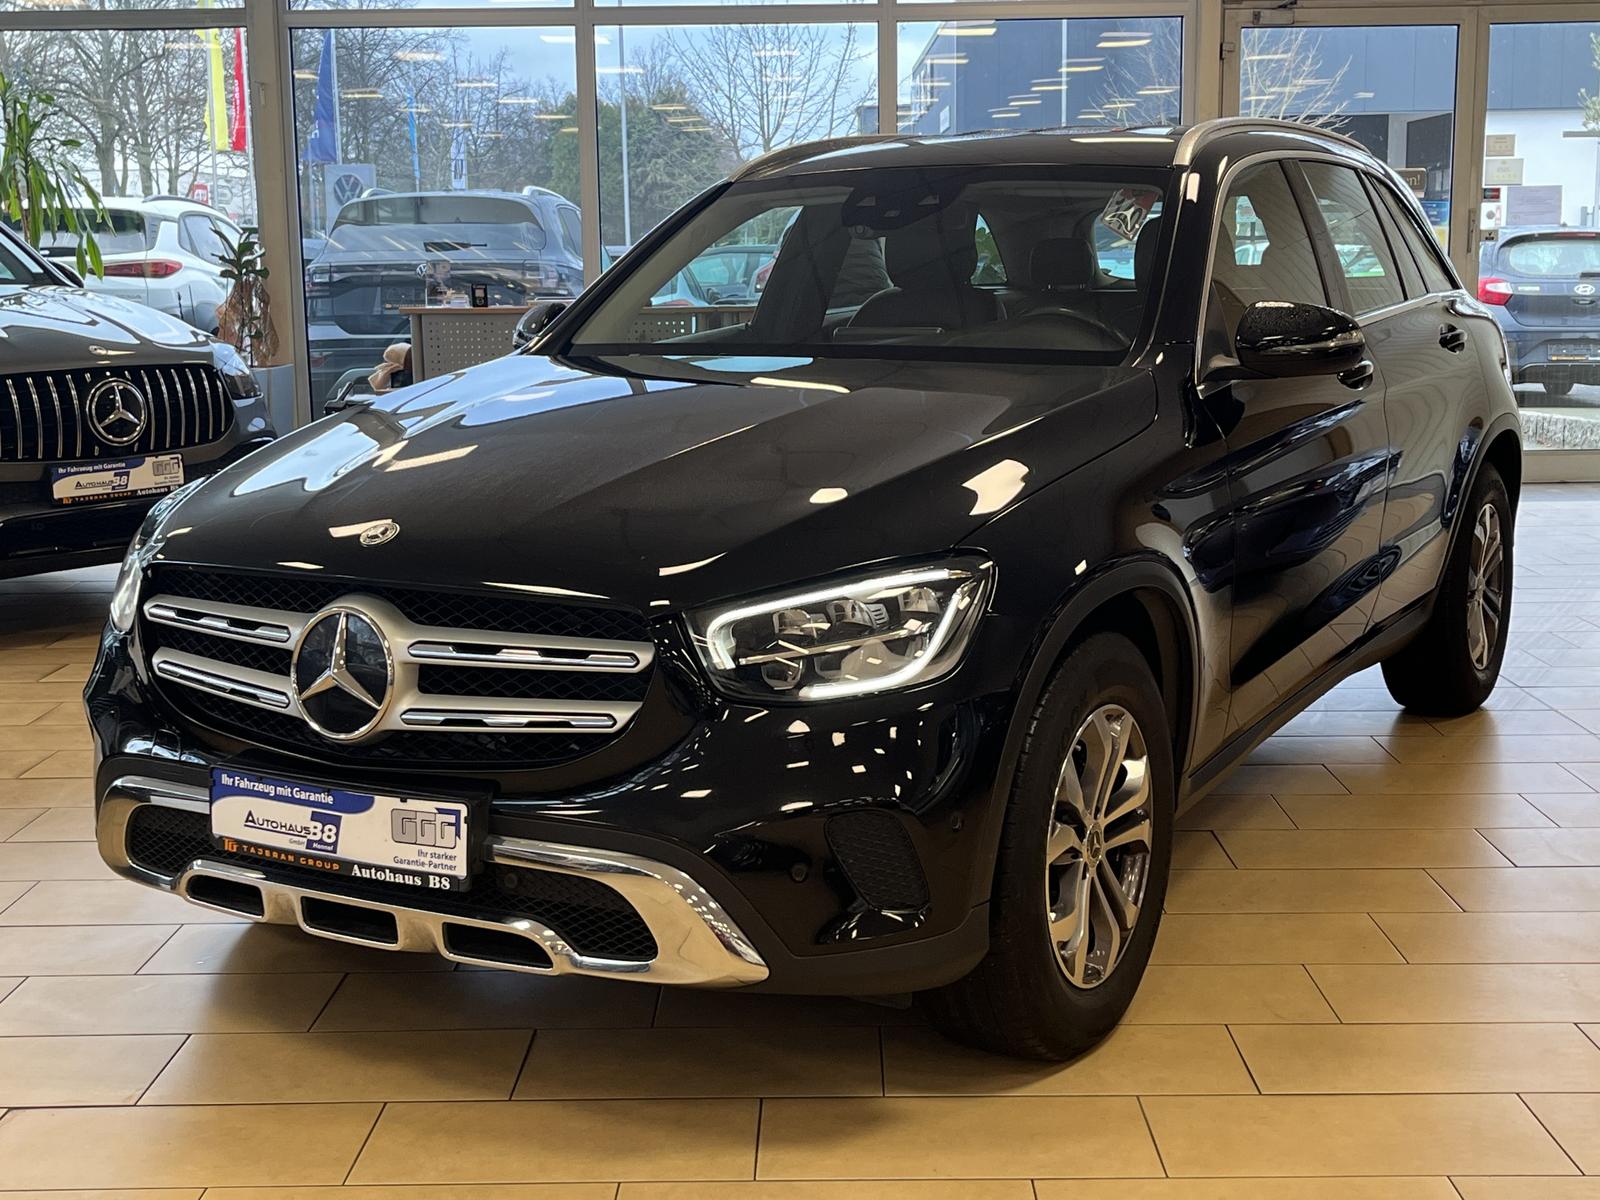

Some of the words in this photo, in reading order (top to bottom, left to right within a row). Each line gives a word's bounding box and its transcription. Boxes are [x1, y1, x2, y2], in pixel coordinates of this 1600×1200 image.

[67, 464, 93, 475] Fahrzeug
[103, 461, 126, 469] Garantie
[136, 486, 168, 496] Autohaus
[221, 774, 233, 786] Ihr
[234, 776, 275, 796] Fahrzeug
[276, 785, 292, 797] mit
[292, 787, 334, 804] Garantie
[391, 808, 457, 850] GGG
[417, 849, 428, 858] Ihr
[429, 850, 457, 861] starker
[299, 856, 340, 871] GROUP
[393, 856, 457, 871] Garantie-Partner
[351, 864, 422, 886] Autohaus
[428, 875, 451, 890] B8
